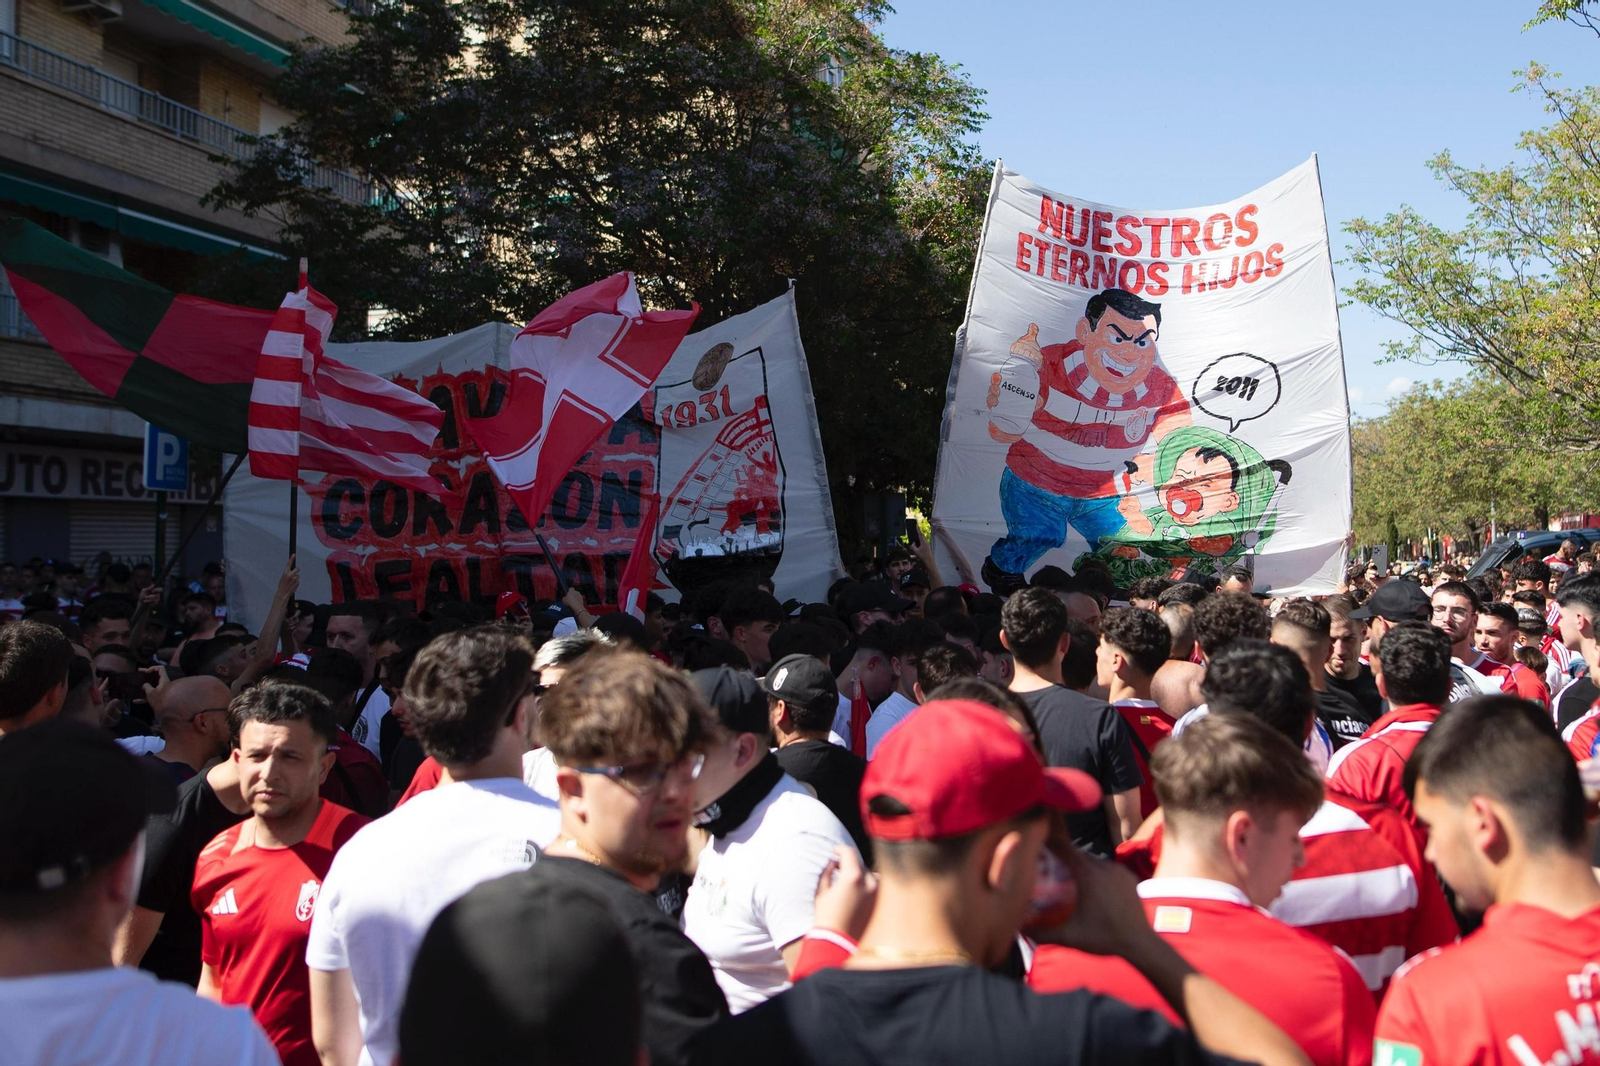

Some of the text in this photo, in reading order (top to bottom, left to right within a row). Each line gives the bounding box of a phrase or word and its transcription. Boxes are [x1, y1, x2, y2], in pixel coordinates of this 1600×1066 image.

[1038, 193, 1259, 259] NUESTROS
[1016, 232, 1285, 297] ETERNOS HIJOS
[660, 384, 738, 429] 1931
[1001, 380, 1036, 401] ASCENSO
[1211, 375, 1259, 401] 2011
[156, 432, 181, 481] P
